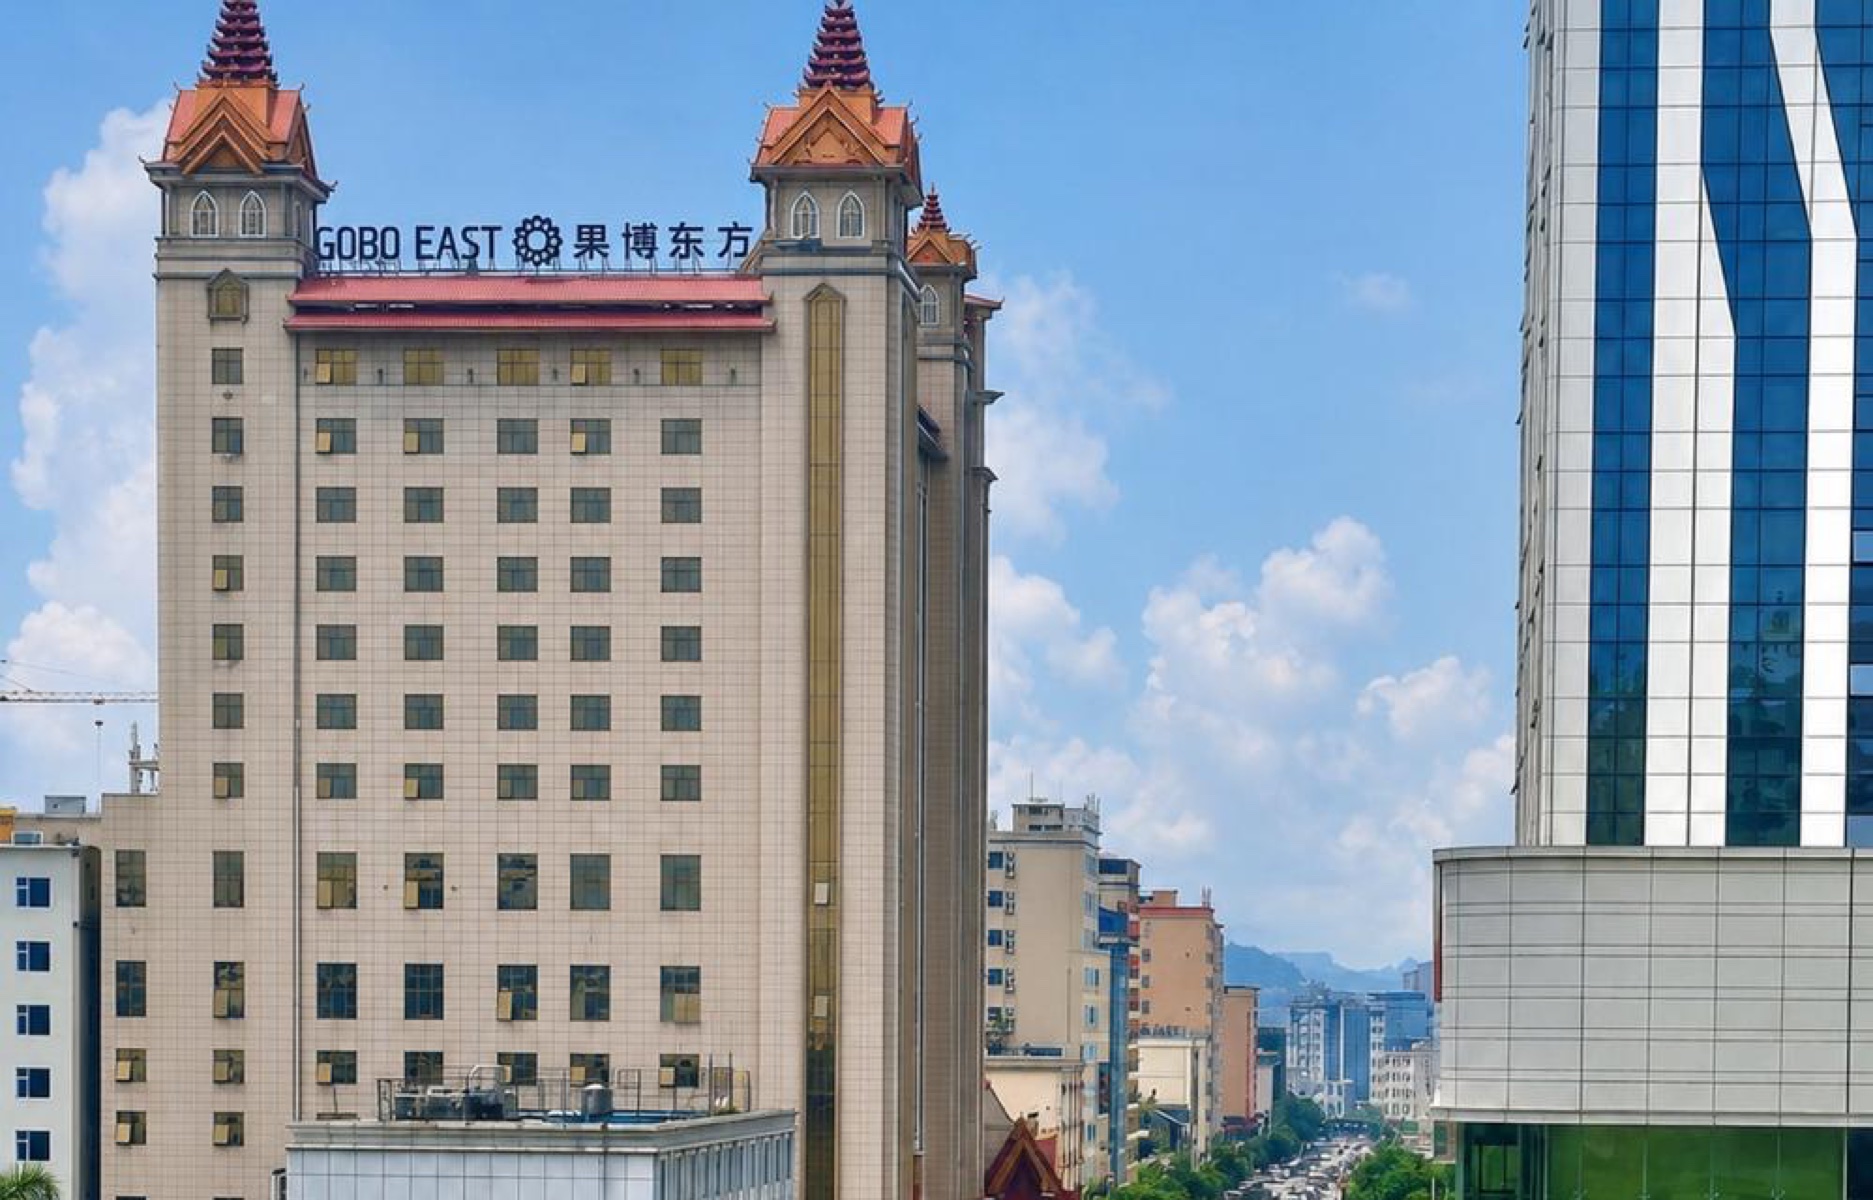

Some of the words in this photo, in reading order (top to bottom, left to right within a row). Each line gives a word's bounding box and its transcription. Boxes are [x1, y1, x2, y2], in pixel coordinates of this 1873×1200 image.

[317, 226, 400, 260] GOBO
[415, 225, 503, 260] EAST
[573, 221, 753, 260] 果博东方
